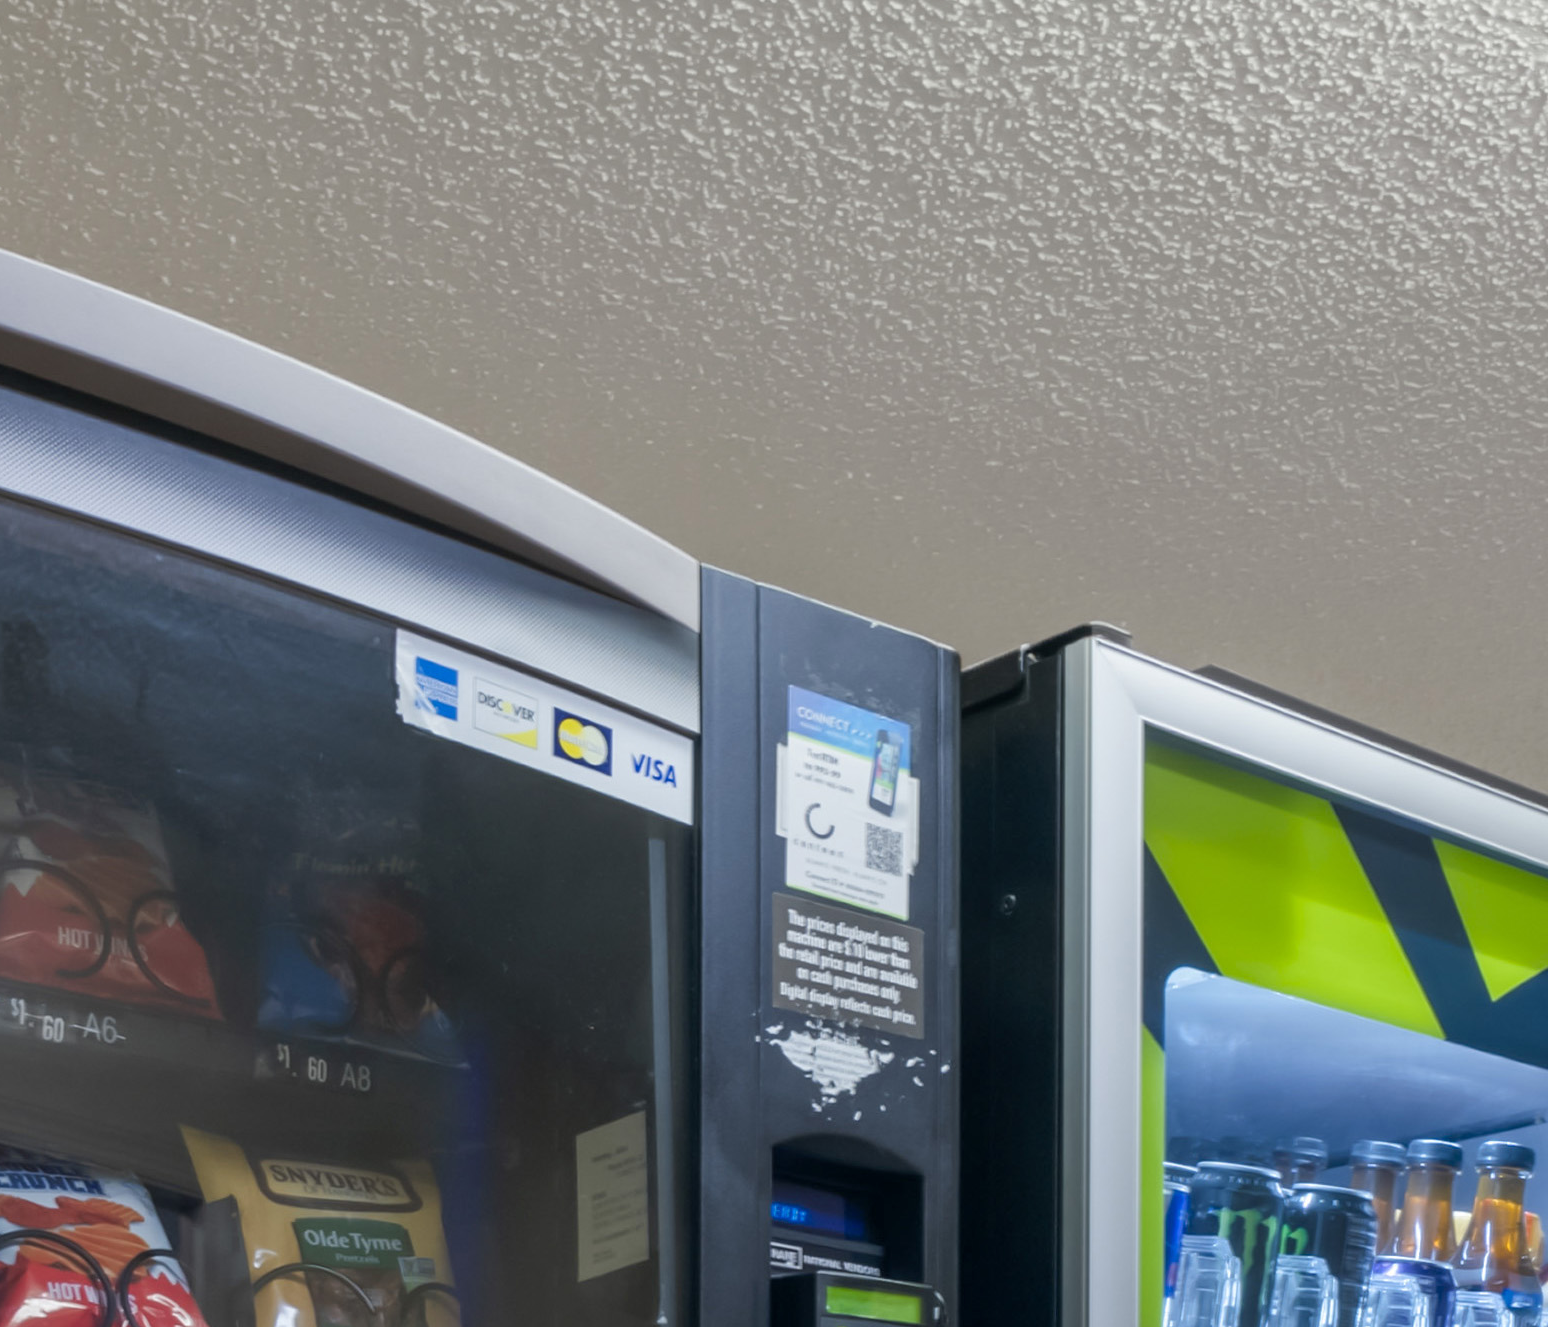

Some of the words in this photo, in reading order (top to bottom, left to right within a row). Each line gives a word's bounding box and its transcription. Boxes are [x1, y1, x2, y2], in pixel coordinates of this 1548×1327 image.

[477, 691, 535, 722] DISCOVER
[631, 752, 677, 788] VISA
[788, 908, 806, 926] The
[806, 916, 835, 937] prices
[836, 922, 878, 946] displayed
[880, 936, 892, 947] on
[892, 936, 910, 953] this
[778, 942, 795, 959] the
[796, 947, 819, 965] retail
[820, 954, 844, 971] price
[845, 959, 863, 975] and
[863, 965, 878, 979] are
[880, 970, 918, 989] available
[787, 930, 827, 949] machine
[828, 939, 843, 954] are
[891, 953, 911, 969] than
[797, 967, 809, 980] on
[810, 970, 832, 985] cash
[833, 975, 879, 996] purchases
[780, 981, 809, 1000] Digital
[809, 987, 839, 1008] display
[840, 995, 872, 1016] reflects
[872, 1004, 892, 1019] cash
[83, 1012, 119, 1044] A6
[340, 1061, 372, 1092] A8
[269, 1165, 398, 1197] SNYDER'S
[303, 1229, 350, 1248] Olde
[350, 1232, 402, 1254] Tyme
[48, 1281, 82, 1301] HOT
